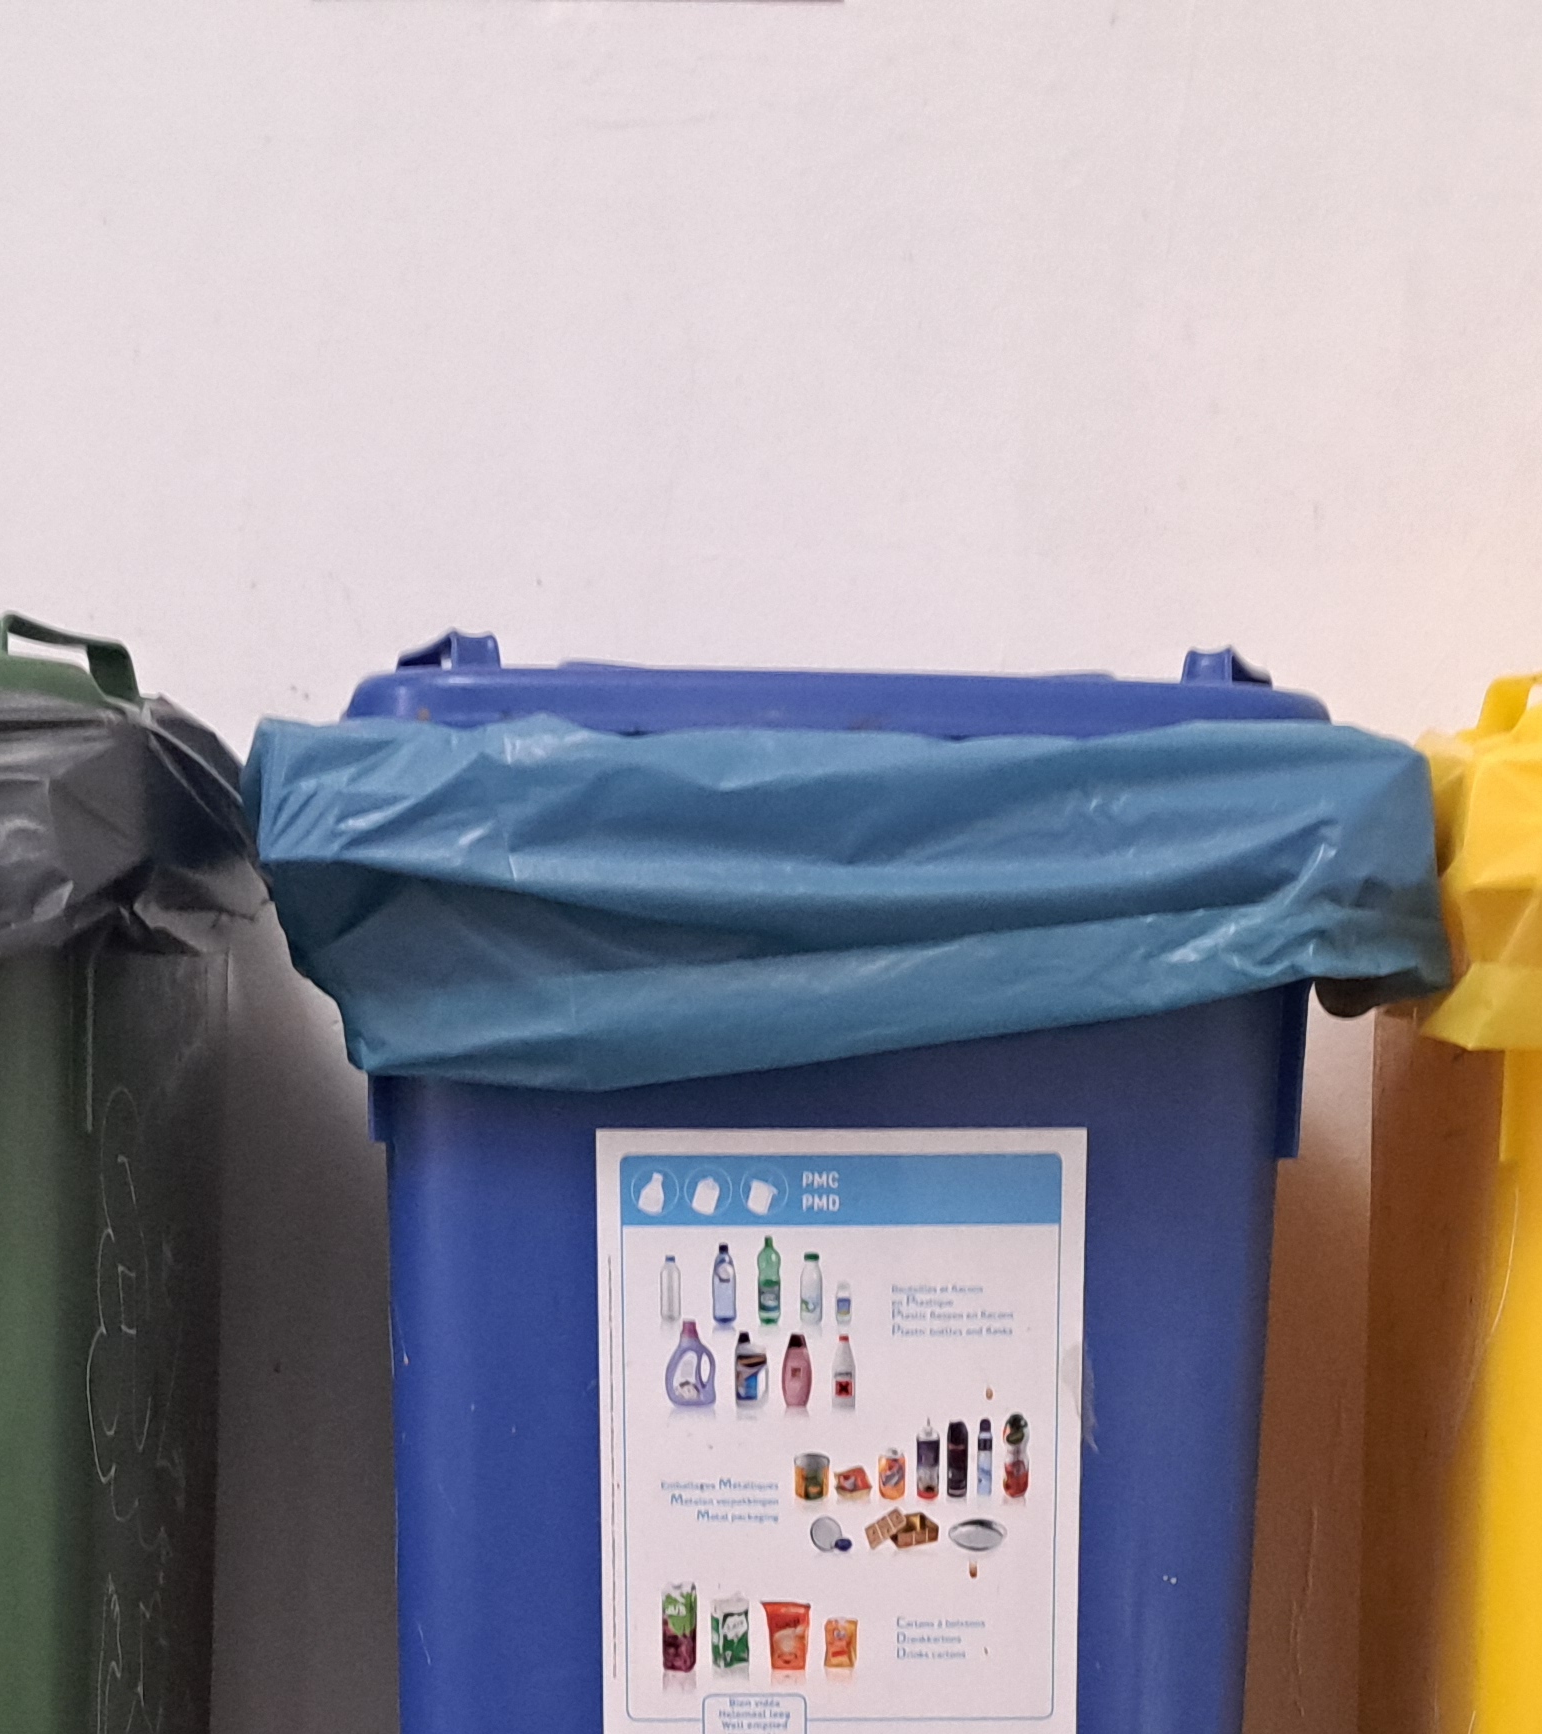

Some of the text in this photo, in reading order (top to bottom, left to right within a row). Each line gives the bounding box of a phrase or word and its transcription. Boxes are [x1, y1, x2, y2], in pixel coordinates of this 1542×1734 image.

[802, 1170, 839, 1189] PMC
[802, 1193, 840, 1212] PMD
[891, 1308, 926, 1321] Plastic
[891, 1322, 926, 1336] Plastic
[696, 1509, 728, 1521] Metal
